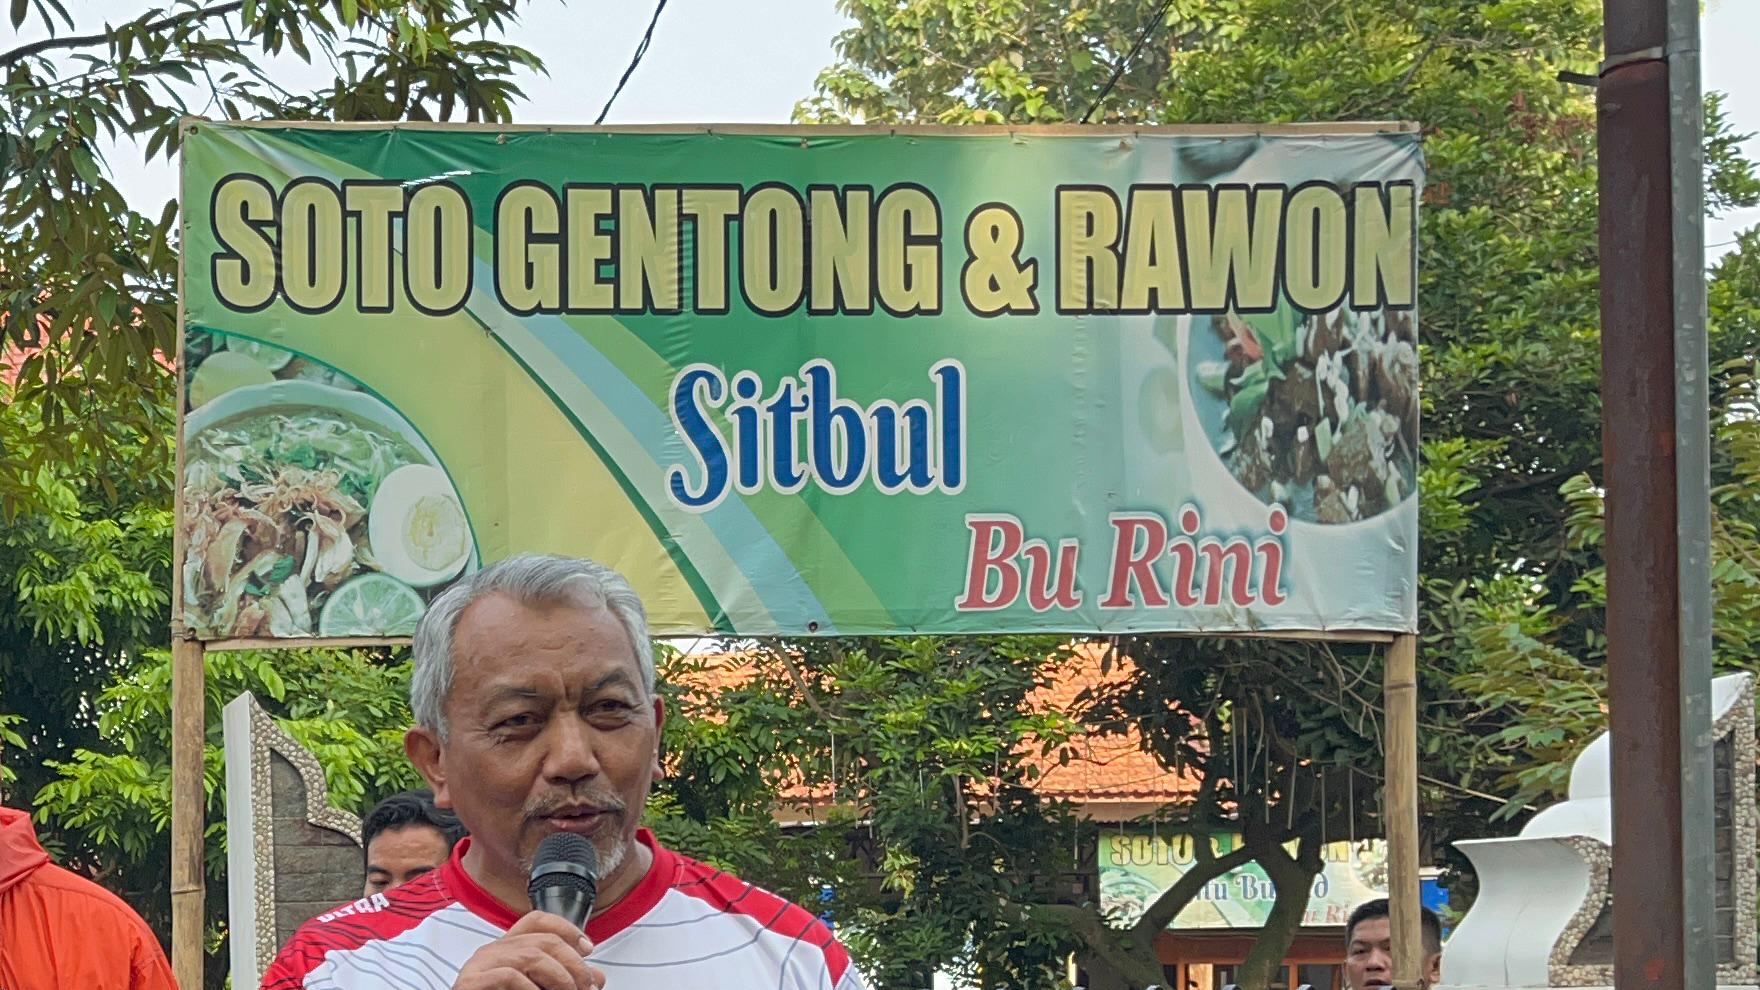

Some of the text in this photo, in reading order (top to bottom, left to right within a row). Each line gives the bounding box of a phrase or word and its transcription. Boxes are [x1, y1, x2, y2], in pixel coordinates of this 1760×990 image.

[211, 173, 1416, 317] SOTO GENTONG & RAWON
[665, 358, 966, 513] Sitbul
[955, 503, 1289, 612] Bu Rini
